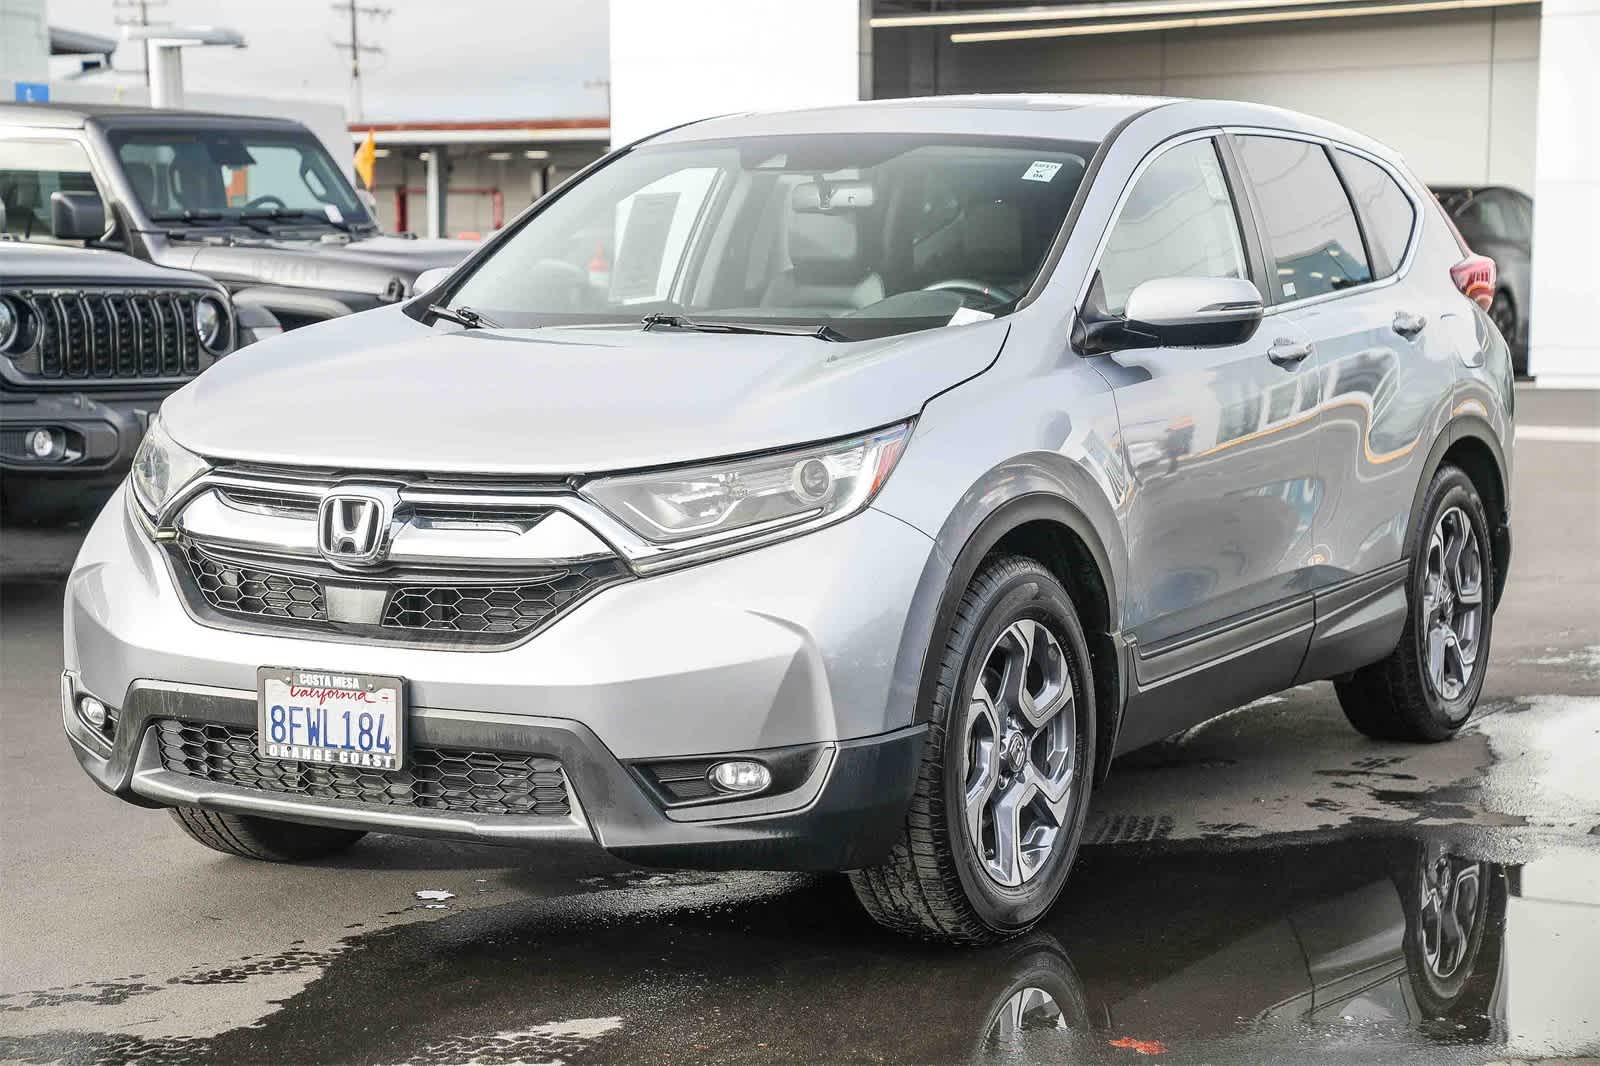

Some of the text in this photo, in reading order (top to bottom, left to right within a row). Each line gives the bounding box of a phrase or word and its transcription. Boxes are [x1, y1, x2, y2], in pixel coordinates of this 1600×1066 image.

[300, 673, 360, 690] COSTA MESA
[290, 685, 376, 706] California
[270, 704, 392, 753] 8FWL184
[269, 744, 393, 768] ORANGE COAST
